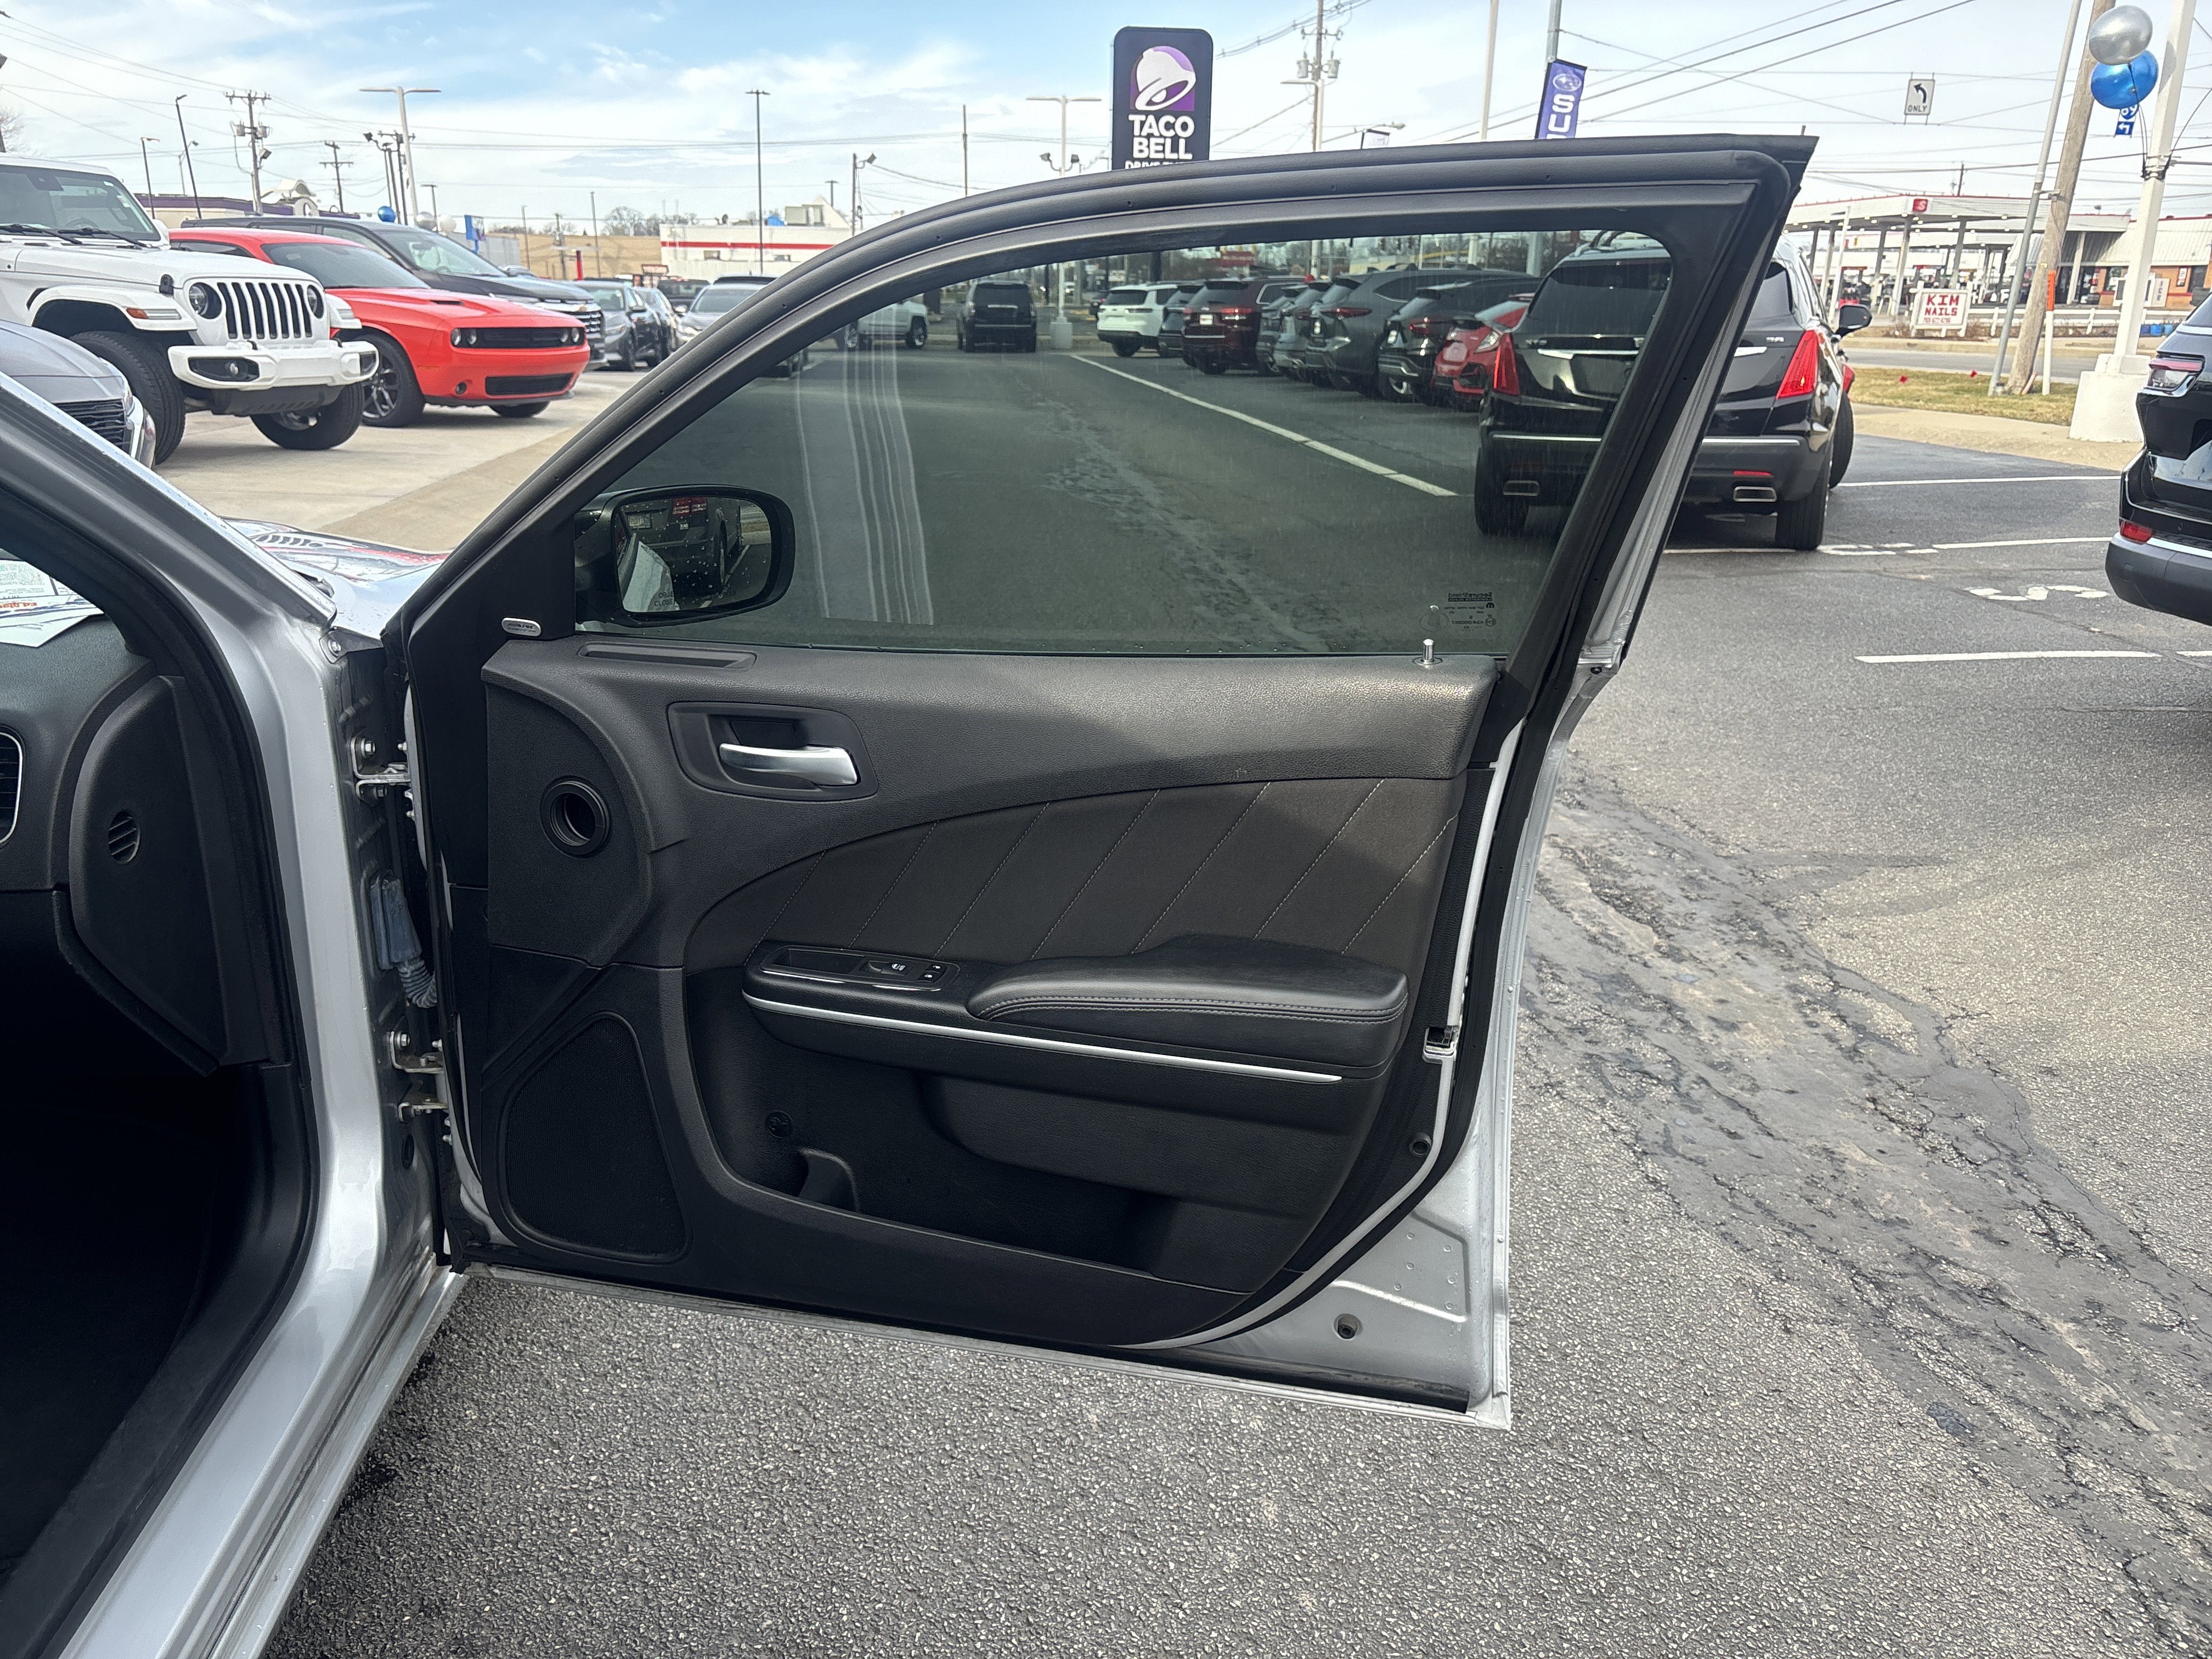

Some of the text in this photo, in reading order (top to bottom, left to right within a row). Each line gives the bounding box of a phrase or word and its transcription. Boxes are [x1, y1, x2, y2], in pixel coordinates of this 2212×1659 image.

[1546, 93, 1575, 139] SU
[1908, 104, 1928, 112] ONLY
[1128, 114, 1195, 137] TACO
[1133, 137, 1193, 160] BELL
[1926, 294, 1960, 306] KIM
[1924, 307, 1958, 317] NAILS
